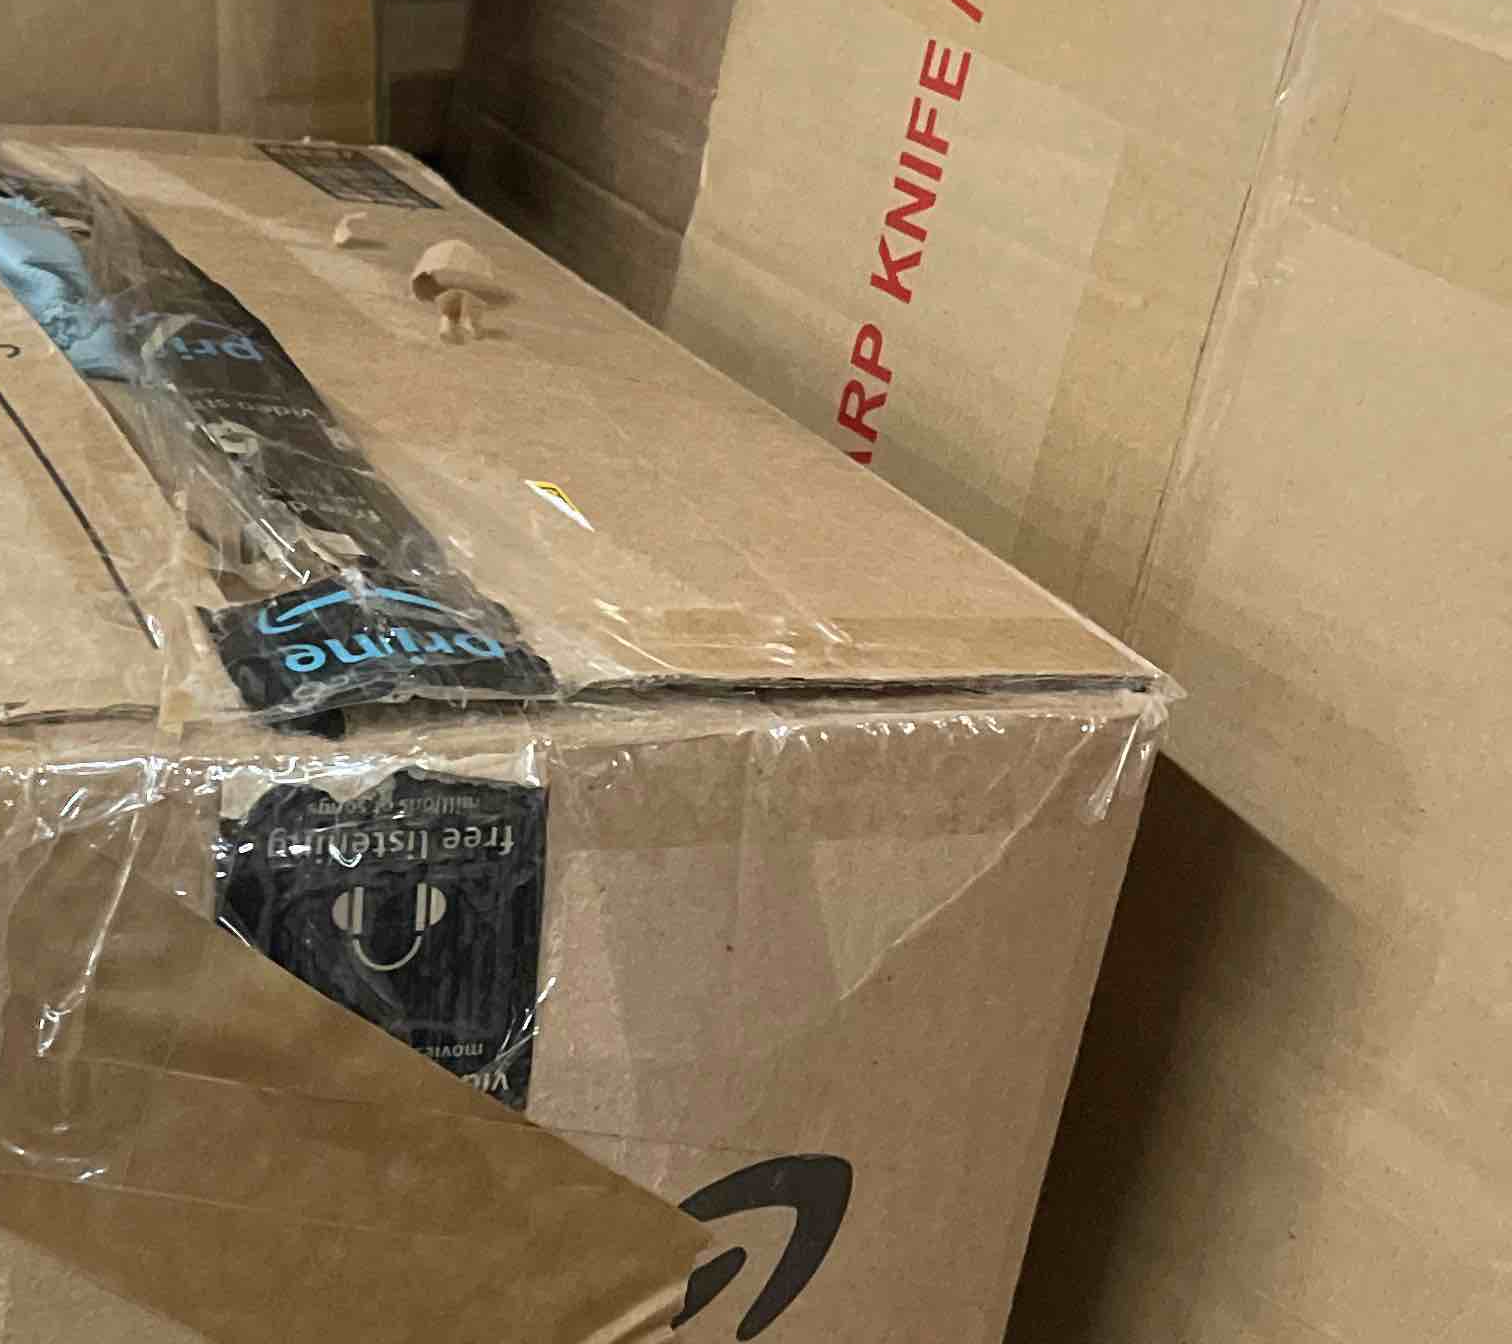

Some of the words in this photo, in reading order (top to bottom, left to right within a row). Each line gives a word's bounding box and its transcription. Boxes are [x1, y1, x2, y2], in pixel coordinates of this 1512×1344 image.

[869, 39, 972, 304] KNIFE
[267, 827, 428, 860] listening
[443, 826, 514, 855] free
